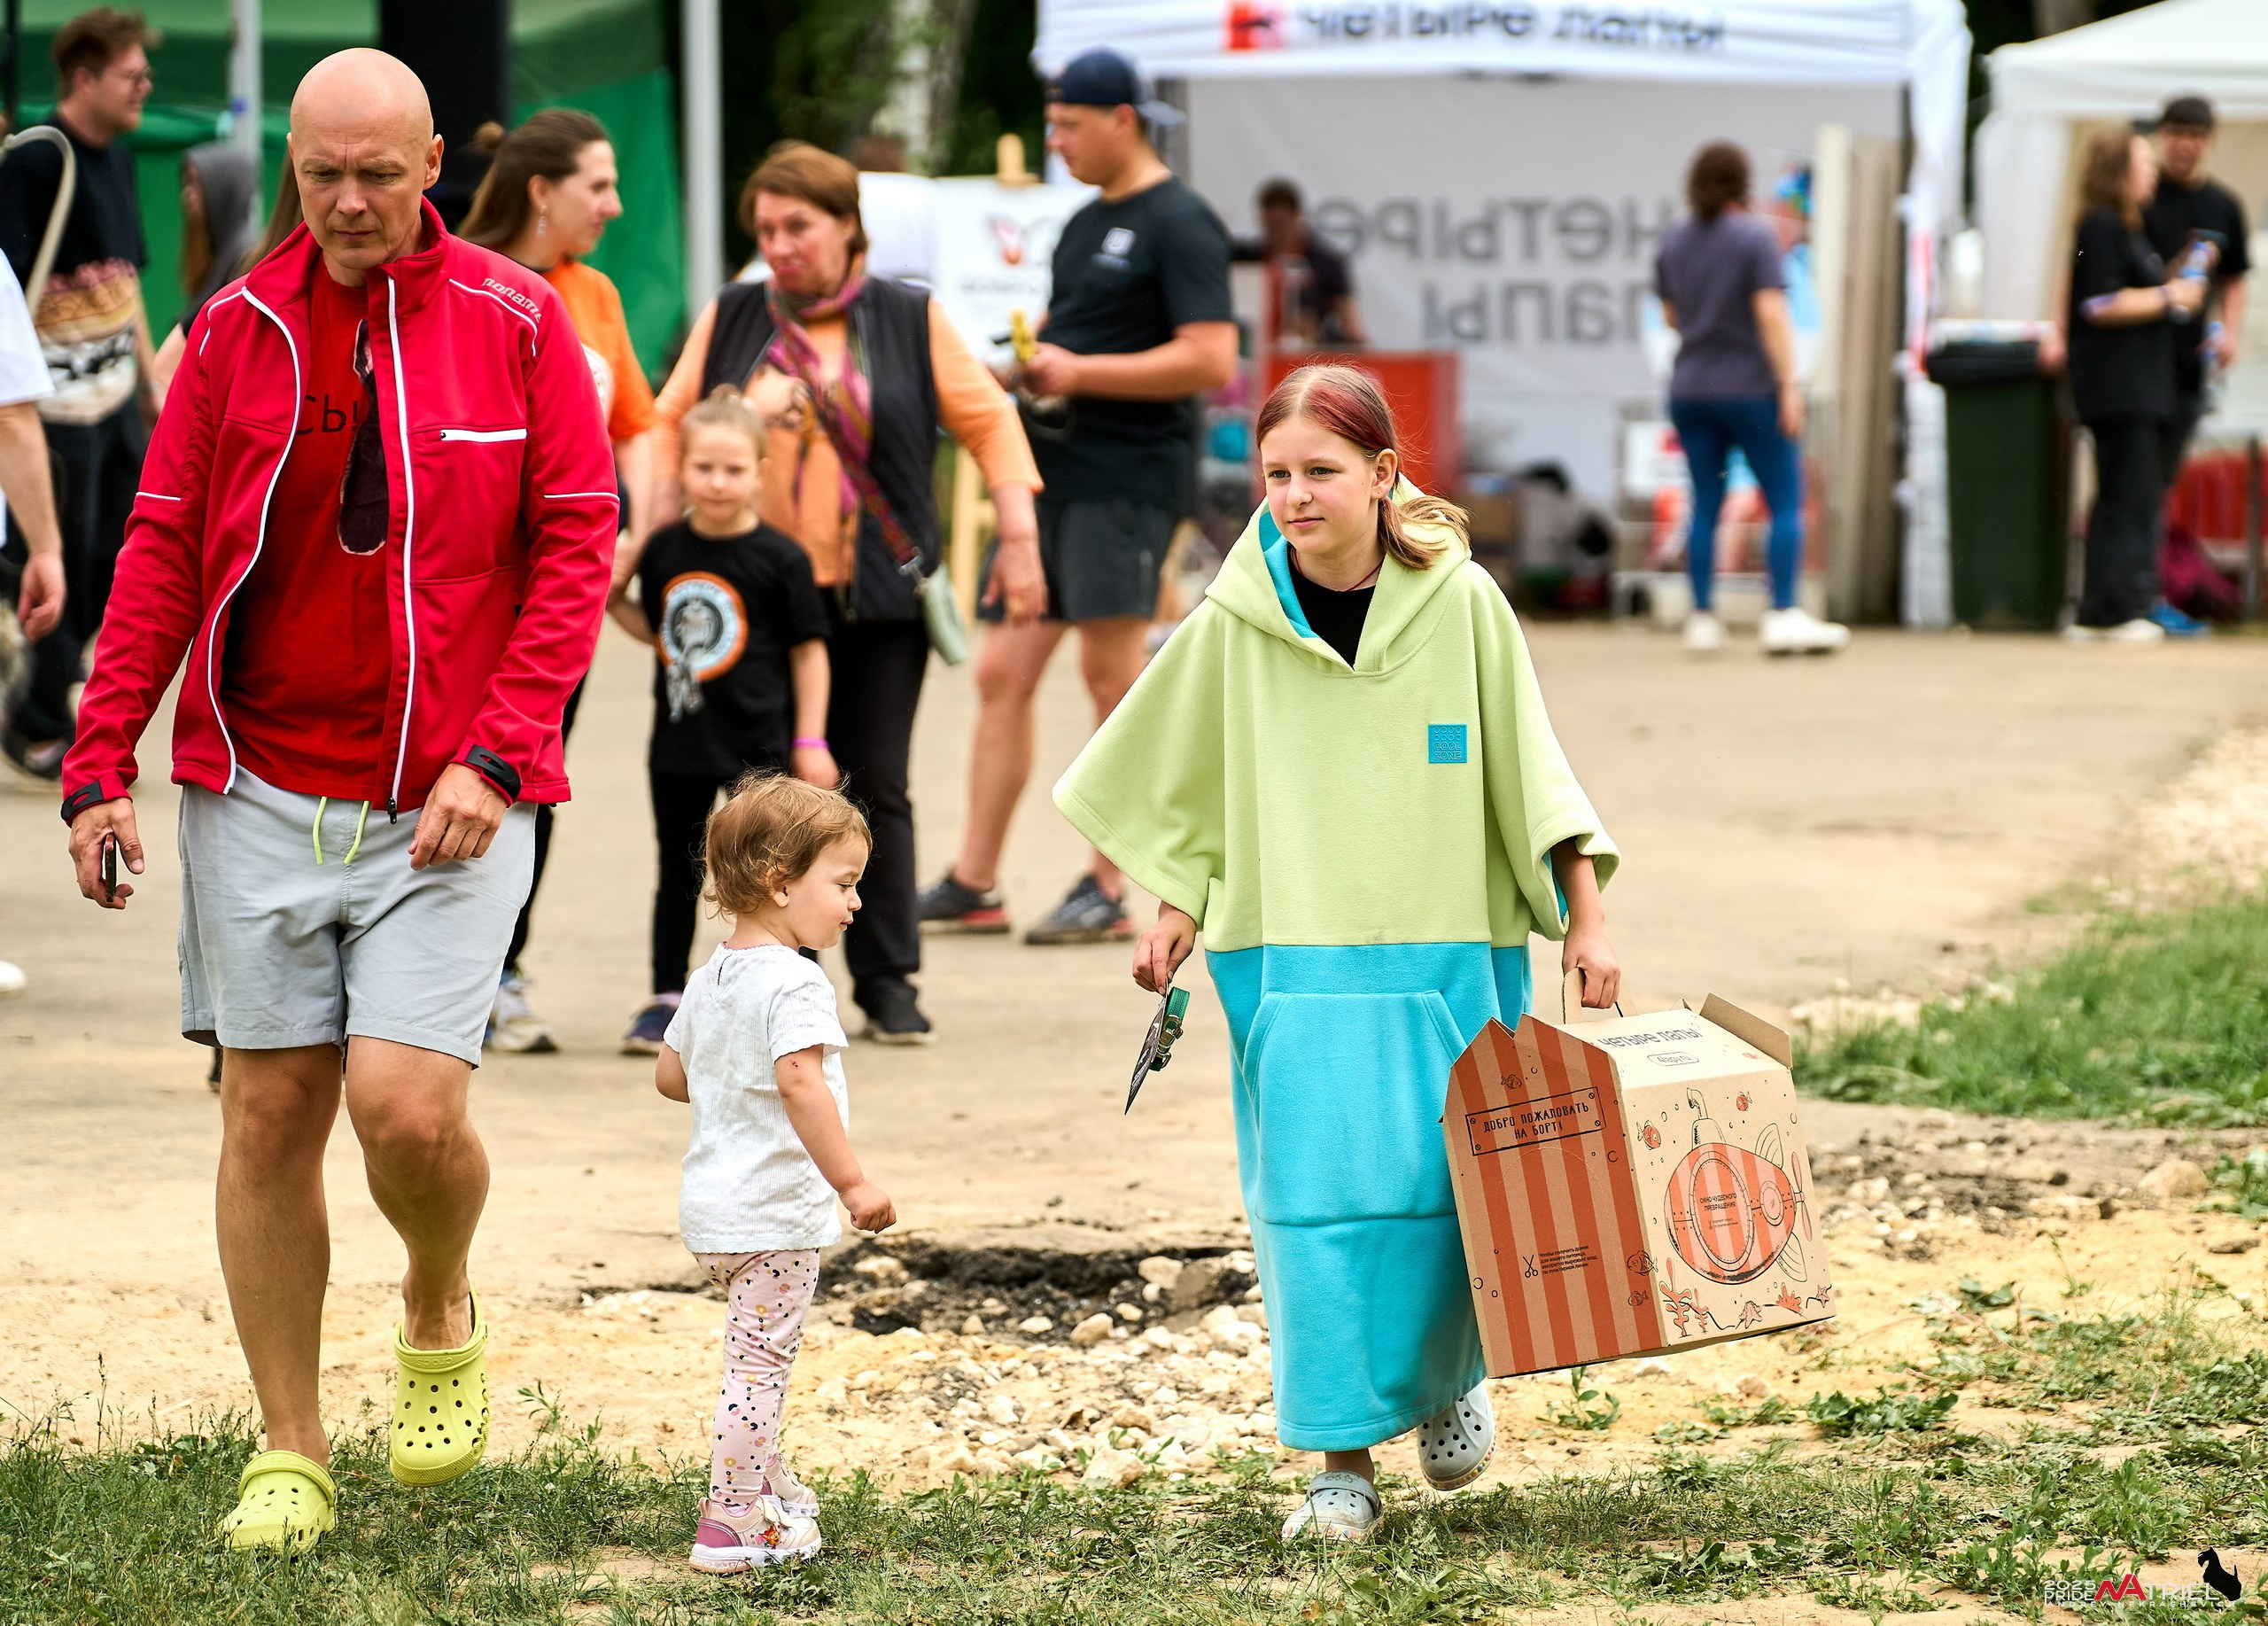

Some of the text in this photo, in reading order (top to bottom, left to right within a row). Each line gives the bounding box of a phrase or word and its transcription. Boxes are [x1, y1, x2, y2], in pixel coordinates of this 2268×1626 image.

[1434, 742, 1462, 751] COOL
[1434, 751, 1462, 760] ZONE
[1483, 1101, 1589, 1133] ДОБРО ПОЖАЛОВАТЬ
[1514, 1120, 1563, 1140] НА БОРТ!
[416, 1357, 454, 1366] crocs
